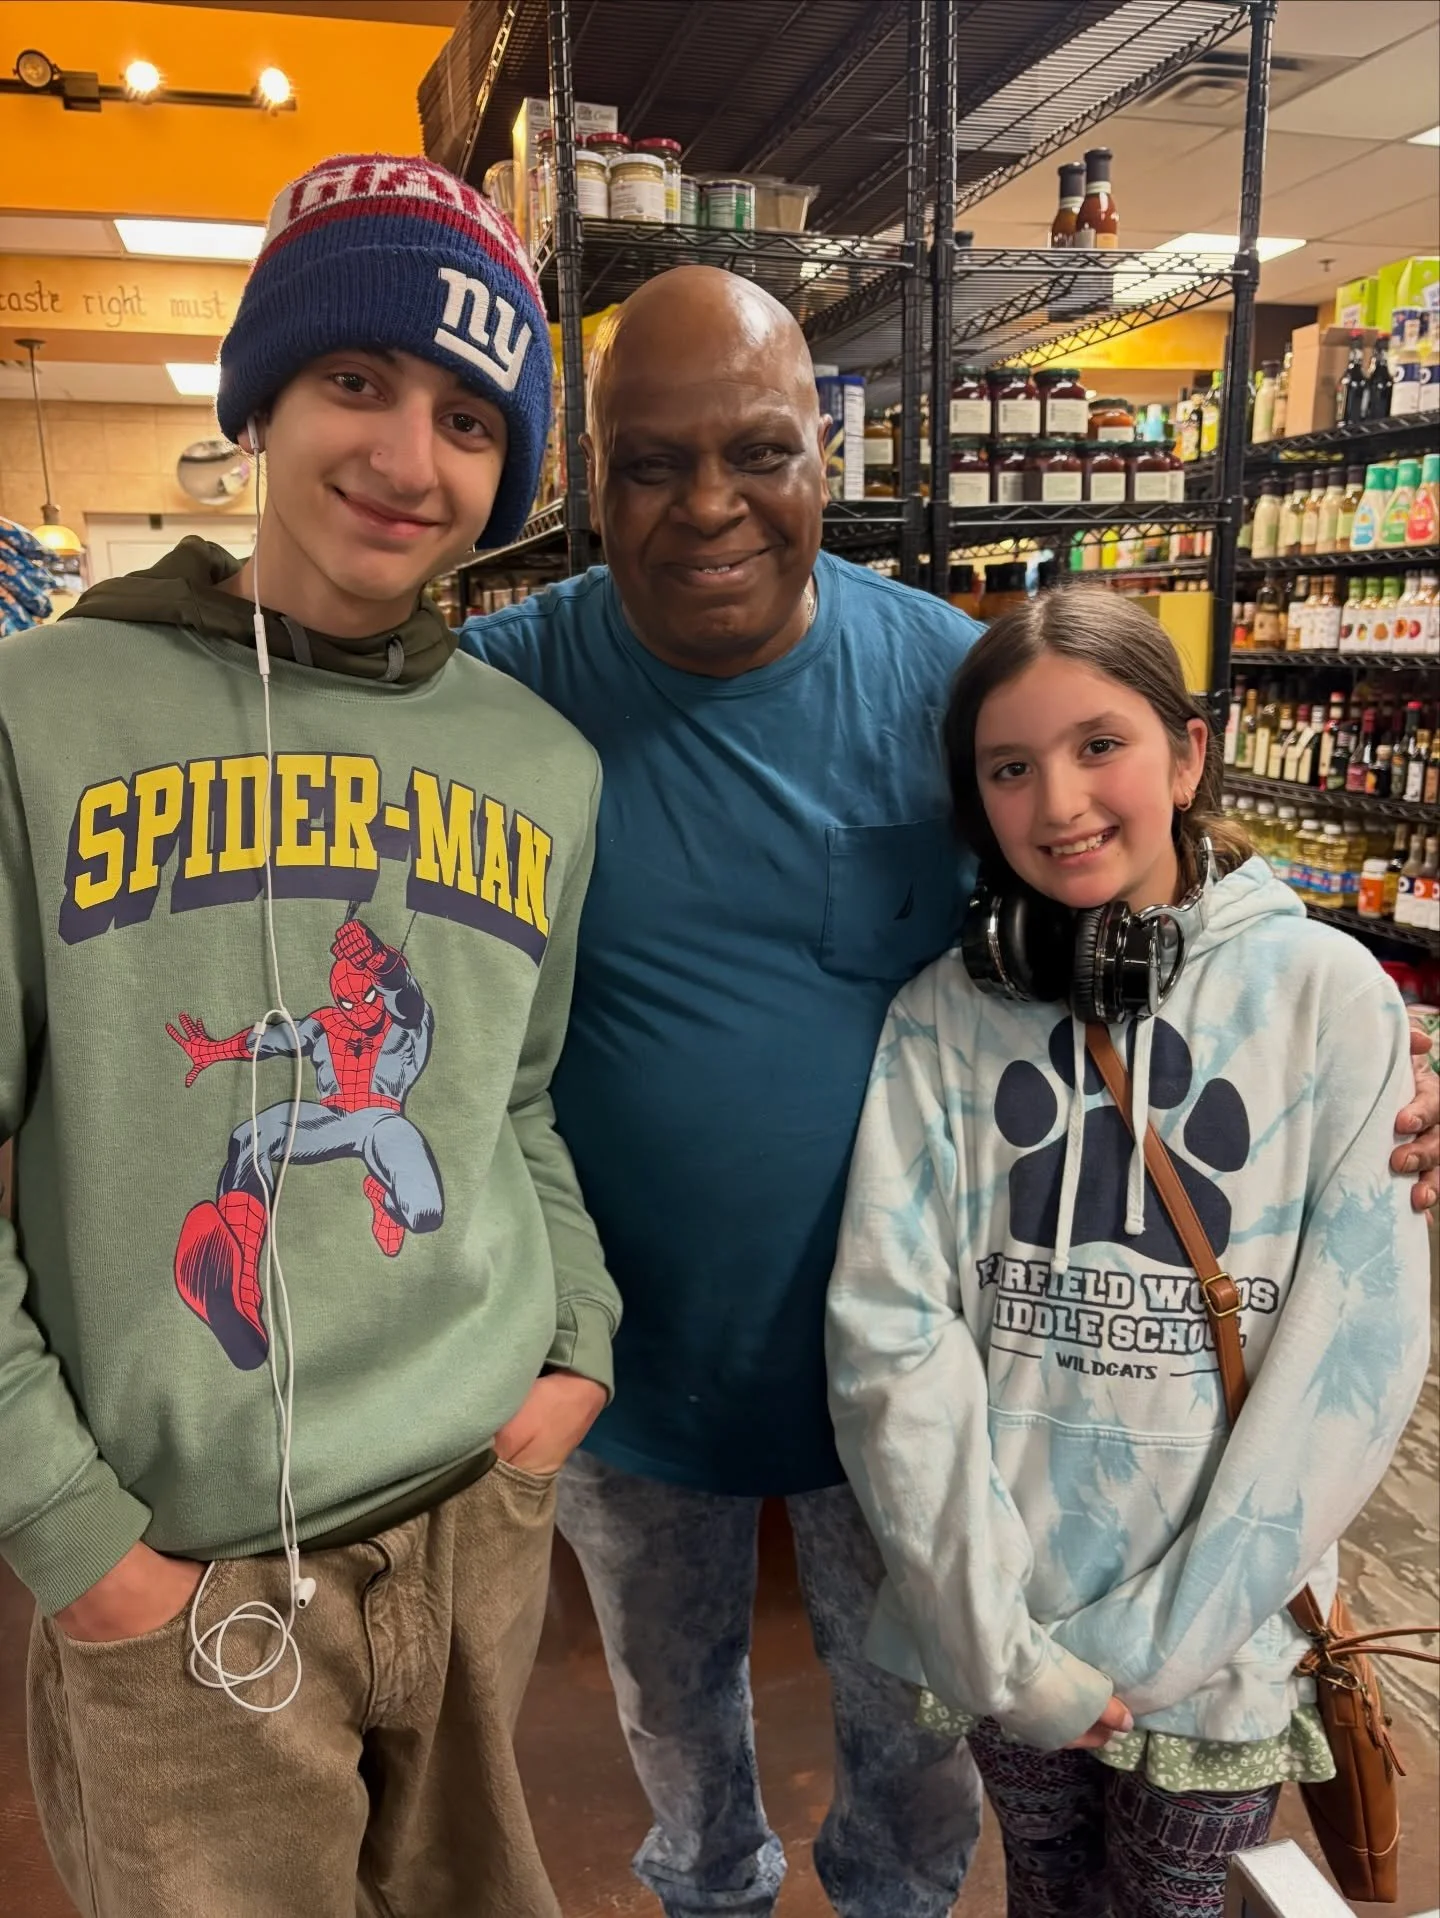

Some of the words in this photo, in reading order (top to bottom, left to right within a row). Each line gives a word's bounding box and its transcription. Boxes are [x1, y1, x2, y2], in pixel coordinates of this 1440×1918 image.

[83, 284, 147, 328] right
[169, 289, 227, 320] must
[60, 752, 553, 965] SPIDER-MAN
[994, 1295, 1103, 1348] IDDLE
[1055, 1351, 1159, 1380] WILDCATS
